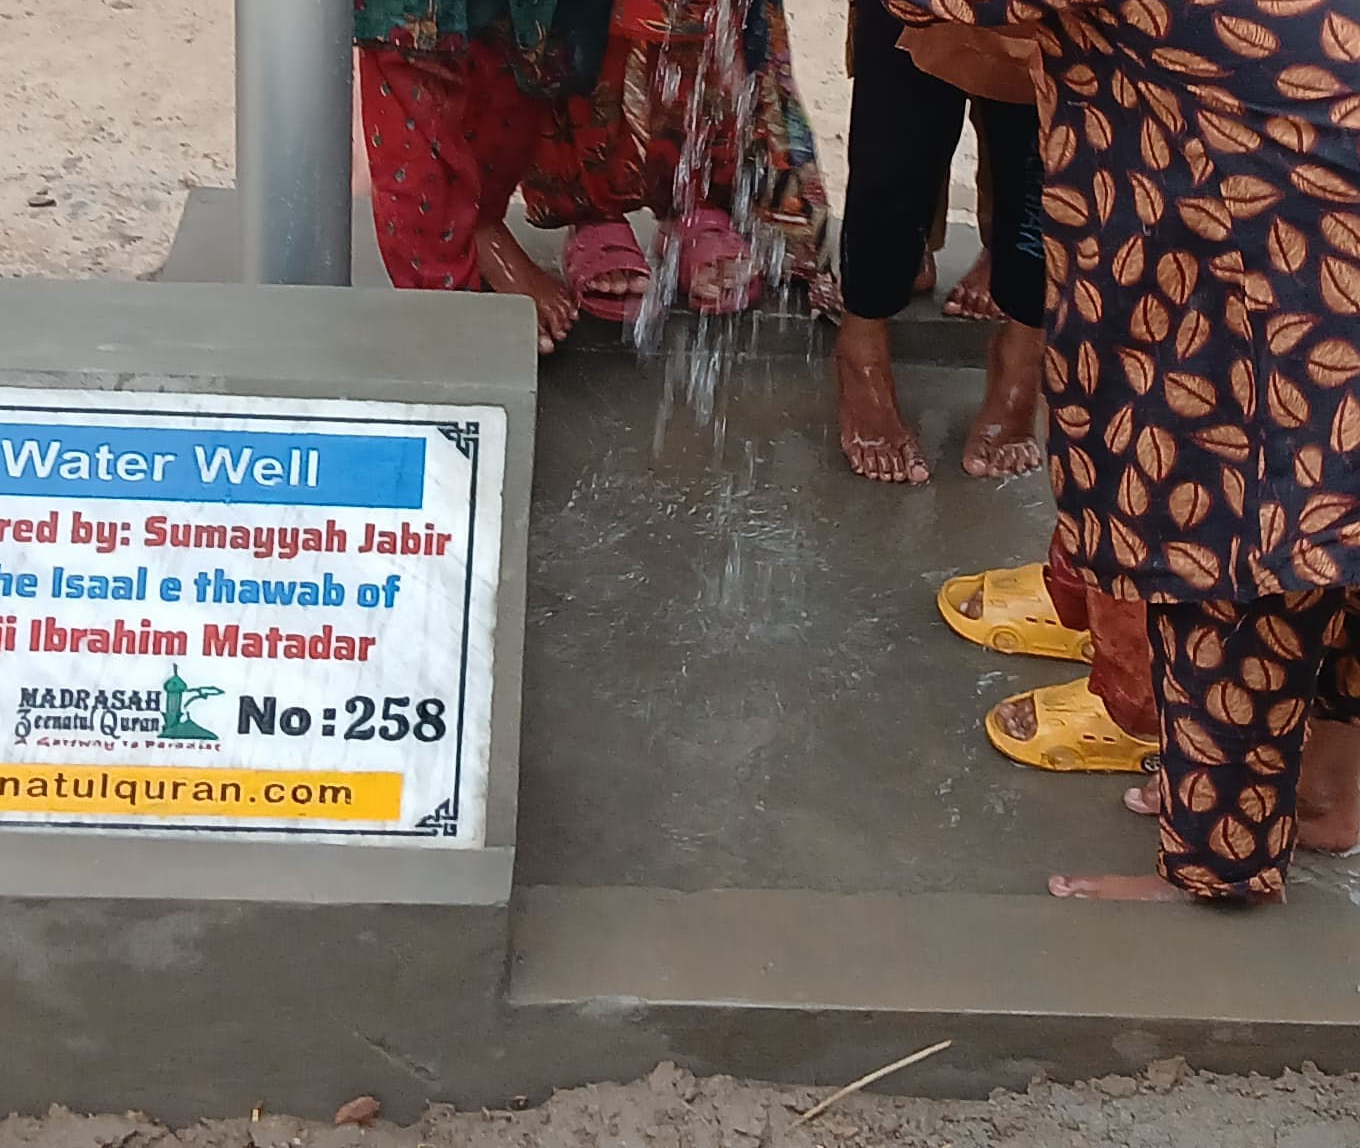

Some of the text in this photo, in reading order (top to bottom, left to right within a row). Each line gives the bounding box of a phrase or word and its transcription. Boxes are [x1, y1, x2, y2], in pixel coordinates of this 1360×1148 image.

[1, 439, 320, 488] Water Well
[71, 512, 132, 552] by:
[144, 515, 347, 559] Sumayyah
[358, 522, 452, 557] Jabir
[51, 566, 149, 601] Isaal
[159, 576, 182, 603] e
[193, 568, 346, 608] thawab
[356, 574, 401, 610] of
[29, 617, 188, 656] Ibrahim
[202, 624, 376, 662] Matadar
[18, 687, 162, 712] MADRASAH
[99, 709, 160, 739] Quran
